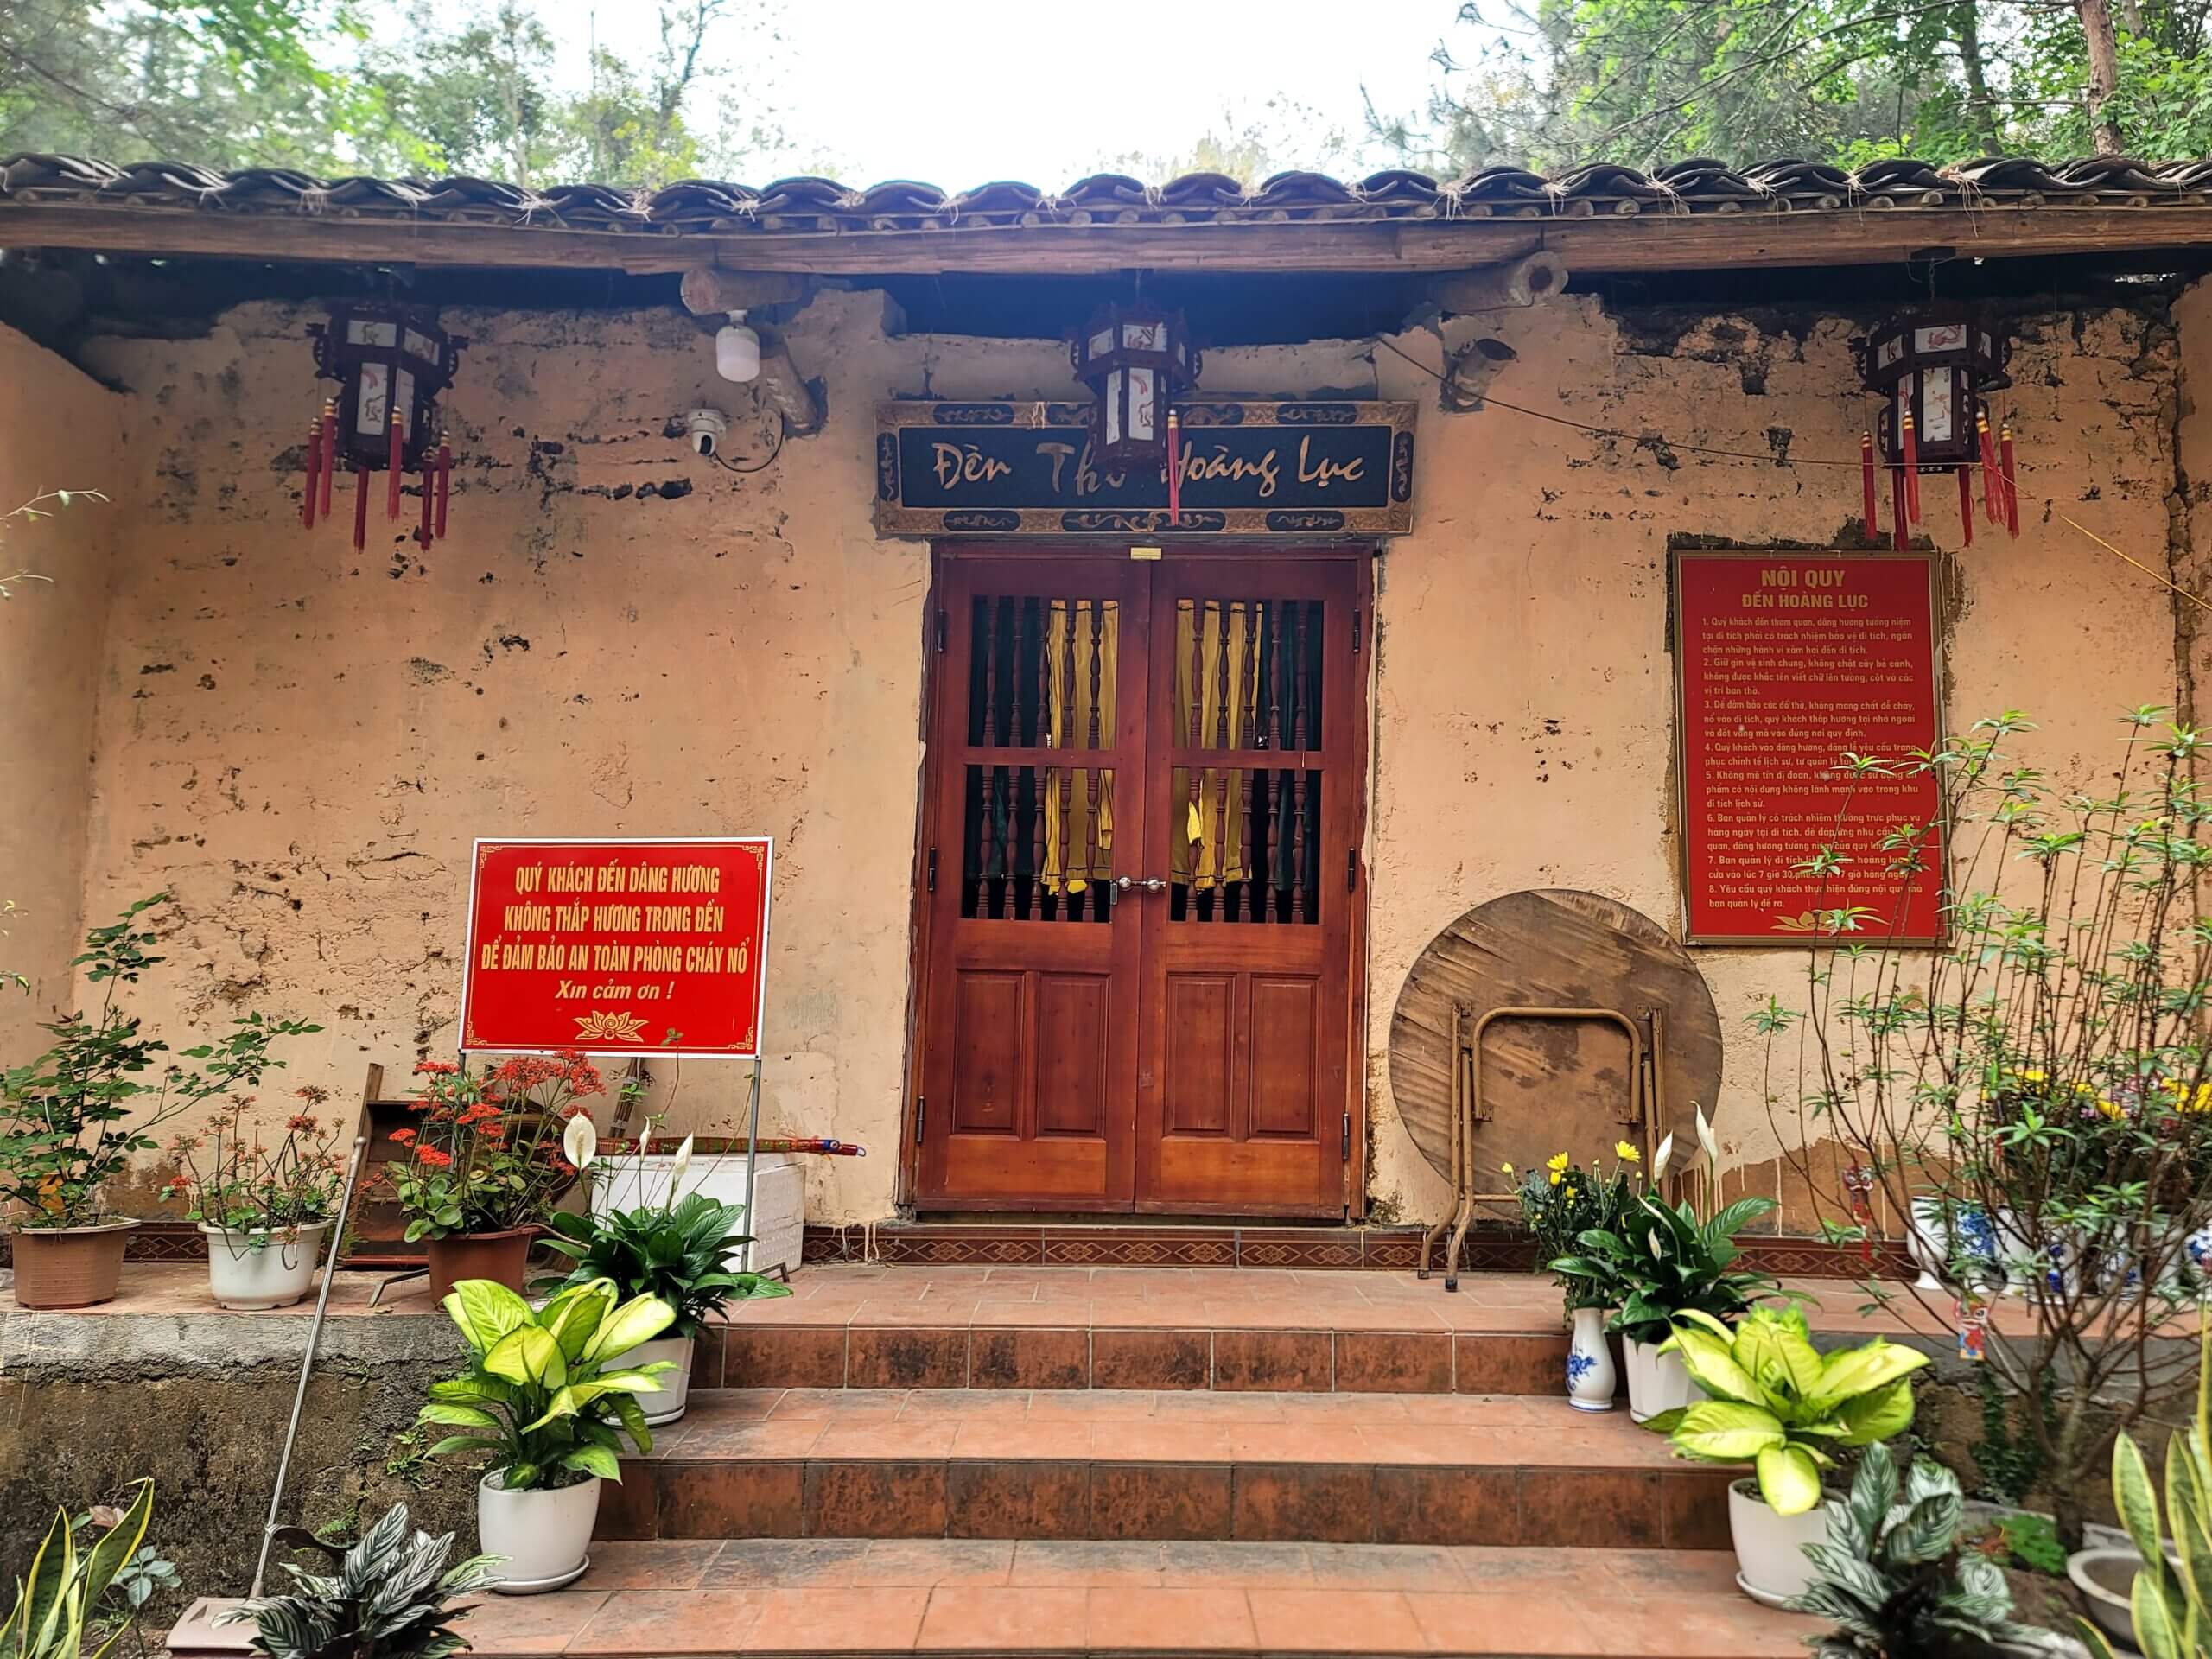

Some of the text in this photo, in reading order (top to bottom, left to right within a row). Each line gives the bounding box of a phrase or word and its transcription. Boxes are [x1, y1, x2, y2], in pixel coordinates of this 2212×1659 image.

[932, 442, 1012, 489] Đền
[1298, 435, 1365, 489] Lục
[1761, 566, 1846, 590] NỘI QUY
[1778, 590, 1833, 608] HOÀNG
[1838, 594, 1869, 612] LỤC
[1771, 617, 1791, 626] tham
[1793, 619, 1815, 629] quan,
[1758, 658, 1776, 667] sinh
[1778, 658, 1806, 670] chung,
[1835, 702, 1858, 712] mang
[1827, 730, 1842, 740] quy
[1759, 784, 1780, 796] dung
[1876, 785, 1899, 796] trong
[1902, 784, 1918, 793] khu
[1717, 813, 1733, 822] Ban
[515, 858, 720, 895] QUÝ KHÁCH ĐẾN DÂNG HƯƠNG
[504, 897, 724, 932] KHÔNG THẮP HƯƠNG TRONG ĐỀN
[480, 934, 750, 974] ĐỂ ĐẢM BẢO AN TOÀN PHÒNG CHÁY NỔ
[555, 978, 675, 1000] Xin cảm ơn !
